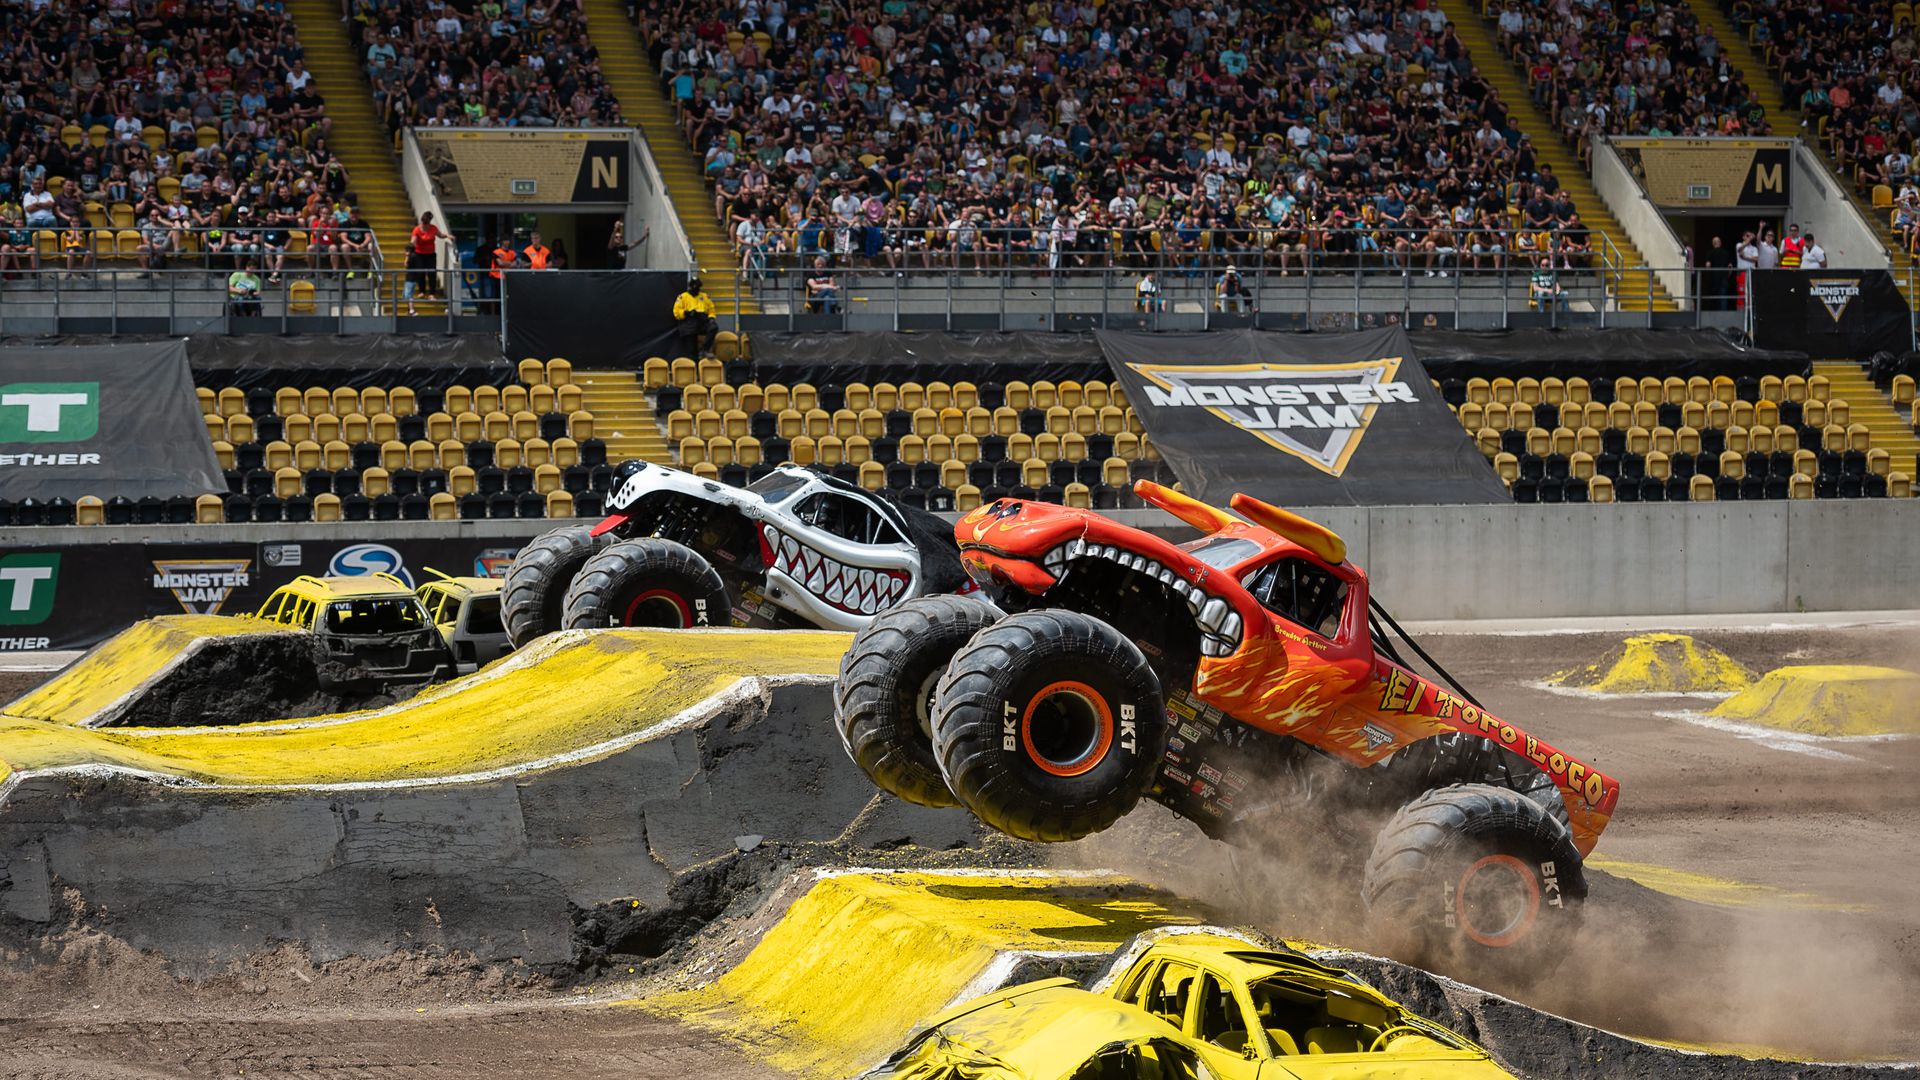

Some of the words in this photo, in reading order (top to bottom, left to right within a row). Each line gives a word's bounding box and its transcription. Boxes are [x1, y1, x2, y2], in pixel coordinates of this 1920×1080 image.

[591, 156, 619, 189] N
[1755, 163, 1783, 194] M
[1809, 286, 1860, 297] MONSTER
[1823, 295, 1847, 305] JAM
[1142, 381, 1420, 407] MONSTER
[1237, 405, 1361, 429] JAM
[153, 572, 249, 588] MONSTER
[180, 587, 223, 602] JAM
[694, 599, 709, 628] BK
[1003, 700, 1018, 752] BKT
[1120, 703, 1137, 755] BKT
[1540, 860, 1564, 910] BKT
